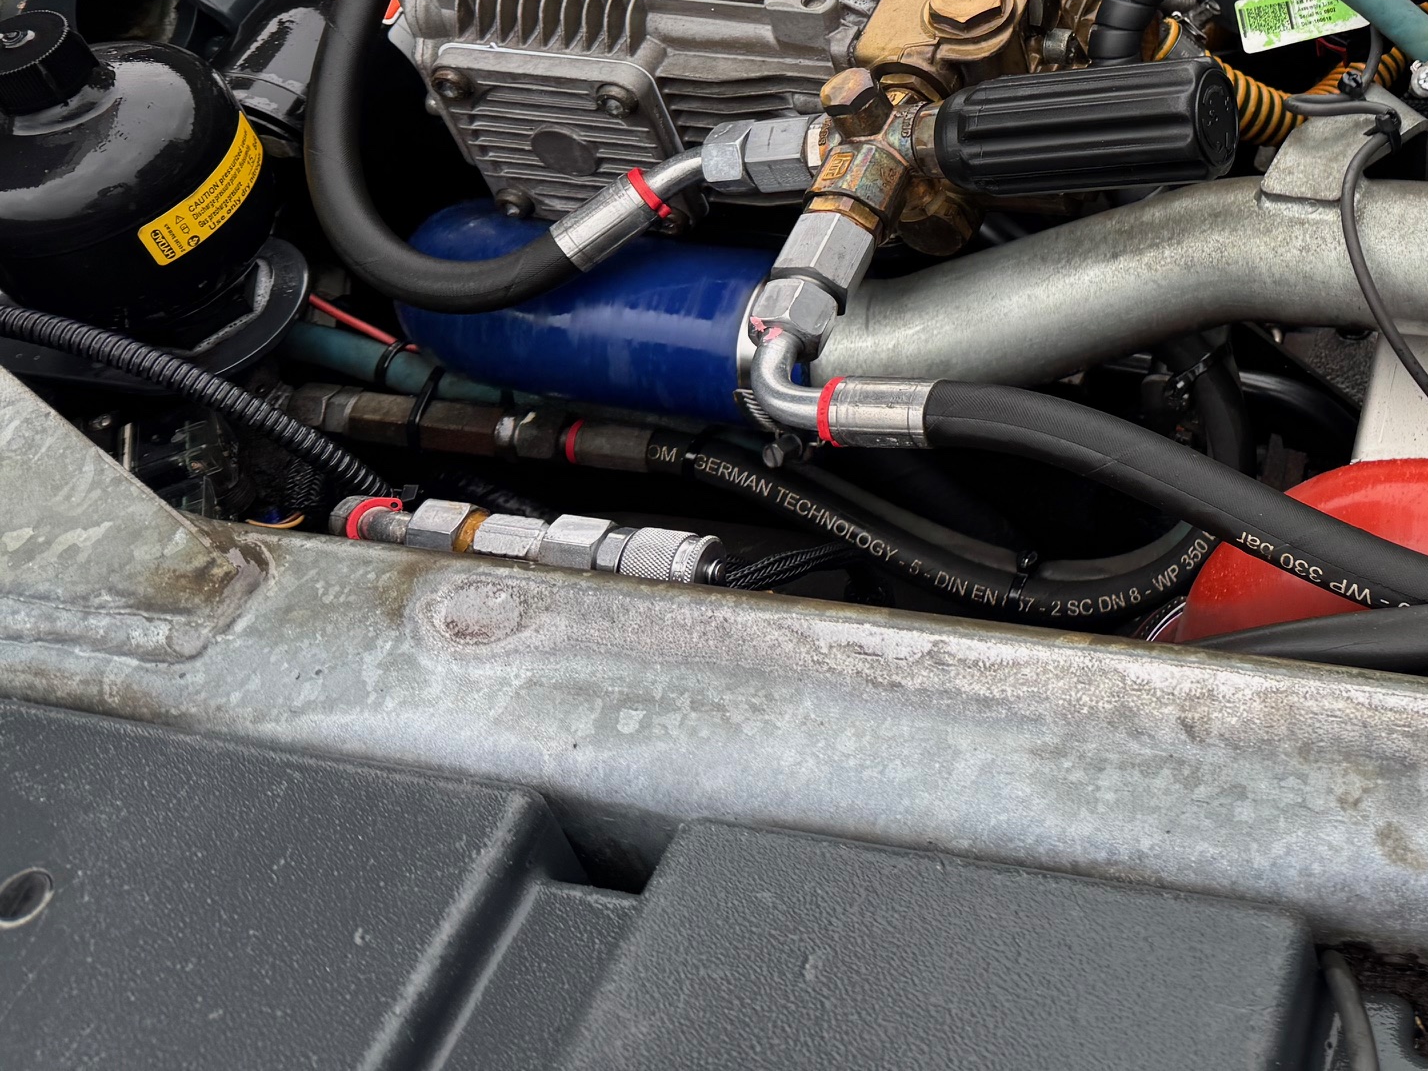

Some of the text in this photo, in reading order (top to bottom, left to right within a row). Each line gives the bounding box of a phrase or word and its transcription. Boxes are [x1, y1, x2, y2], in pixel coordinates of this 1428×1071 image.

[188, 182, 220, 213] CAUTION
[219, 146, 242, 186] pressurized
[192, 195, 217, 220] Discharge
[209, 214, 226, 231] Use
[227, 197, 242, 215] only
[241, 185, 251, 197] dry
[151, 230, 175, 259] HYDAC
[694, 454, 774, 497] GERMAN
[776, 486, 898, 561] TECHNOLOGY
[934, 571, 968, 597] DIN
[971, 586, 998, 607] EN
[1051, 601, 1062, 616] 2
[1067, 599, 1094, 616] SC
[1098, 593, 1127, 614] DN
[1128, 587, 1142, 604] 8
[1151, 566, 1180, 592] WP
[1180, 538, 1209, 571] 350
[1236, 531, 1274, 560] bar
[1279, 552, 1323, 583] 330
[1329, 578, 1372, 605] WP
